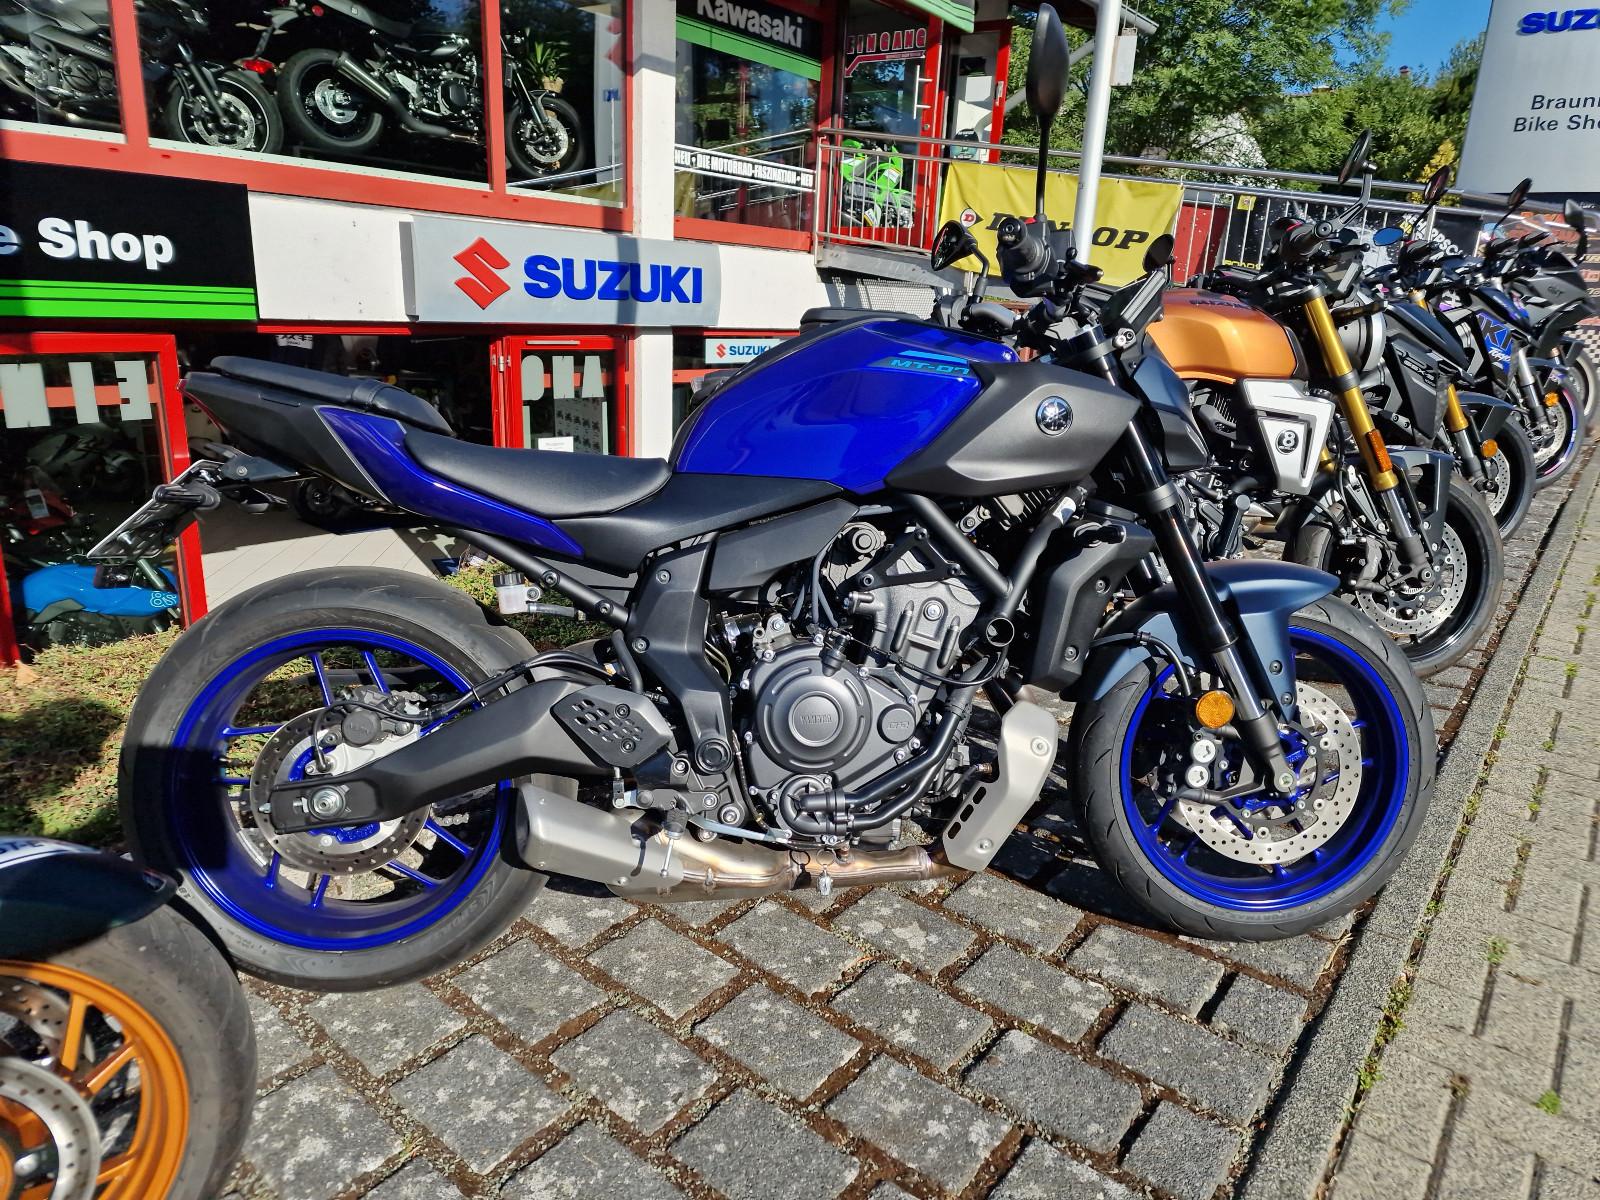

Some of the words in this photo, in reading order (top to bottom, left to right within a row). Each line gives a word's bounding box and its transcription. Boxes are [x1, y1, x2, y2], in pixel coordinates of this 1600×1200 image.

[697, 0, 803, 48] Kawasaki
[1519, 8, 1600, 35] SUZ
[1531, 94, 1600, 111] Braun
[1513, 115, 1559, 132] Bike
[1567, 114, 1600, 131] Sh
[37, 216, 174, 270] Shop
[523, 253, 703, 304] SUZUKI
[728, 344, 772, 356] SUZUK
[890, 359, 970, 375] MT-07
[1282, 429, 1297, 447] 8
